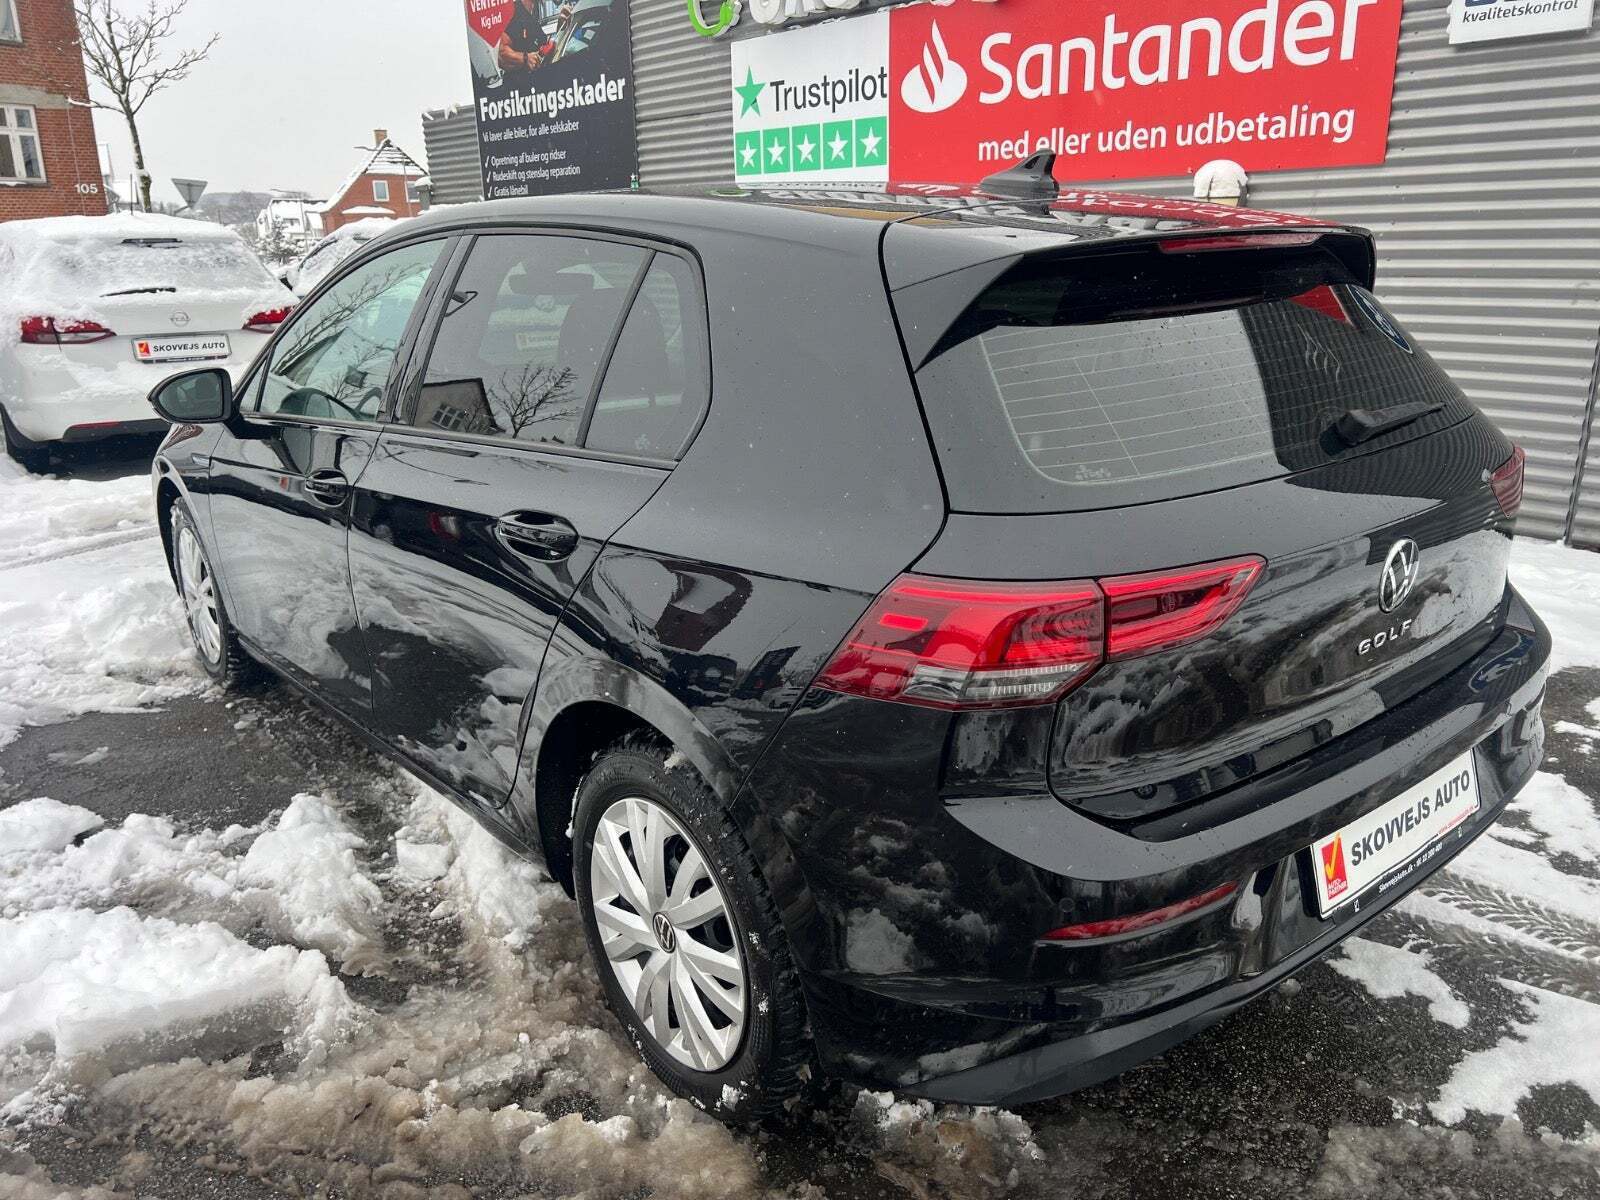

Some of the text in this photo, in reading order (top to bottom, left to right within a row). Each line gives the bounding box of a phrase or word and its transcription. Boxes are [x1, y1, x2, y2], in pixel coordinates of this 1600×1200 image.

[480, 11, 502, 29] Kig ind
[1462, 0, 1579, 23] kvalitetskontrol
[978, 0, 1378, 104] Santander
[479, 73, 626, 122] Forsikringsskader
[769, 66, 888, 114] Trustpilot
[489, 130, 503, 142] laver
[503, 128, 514, 140] alle
[528, 124, 538, 137] for
[538, 123, 550, 135] alle
[549, 119, 580, 134] selskaber
[977, 105, 1355, 161] med eller uden udbetaling
[540, 152, 549, 164] og
[517, 170, 526, 182] og
[549, 164, 581, 179] reparation
[74, 183, 98, 194] 105
[153, 342, 225, 352] SKOVVEJS AUTO
[1358, 618, 1412, 656] GOLF
[1351, 796, 1431, 867] SKOVVEJS
[1434, 769, 1470, 812] AUTO
